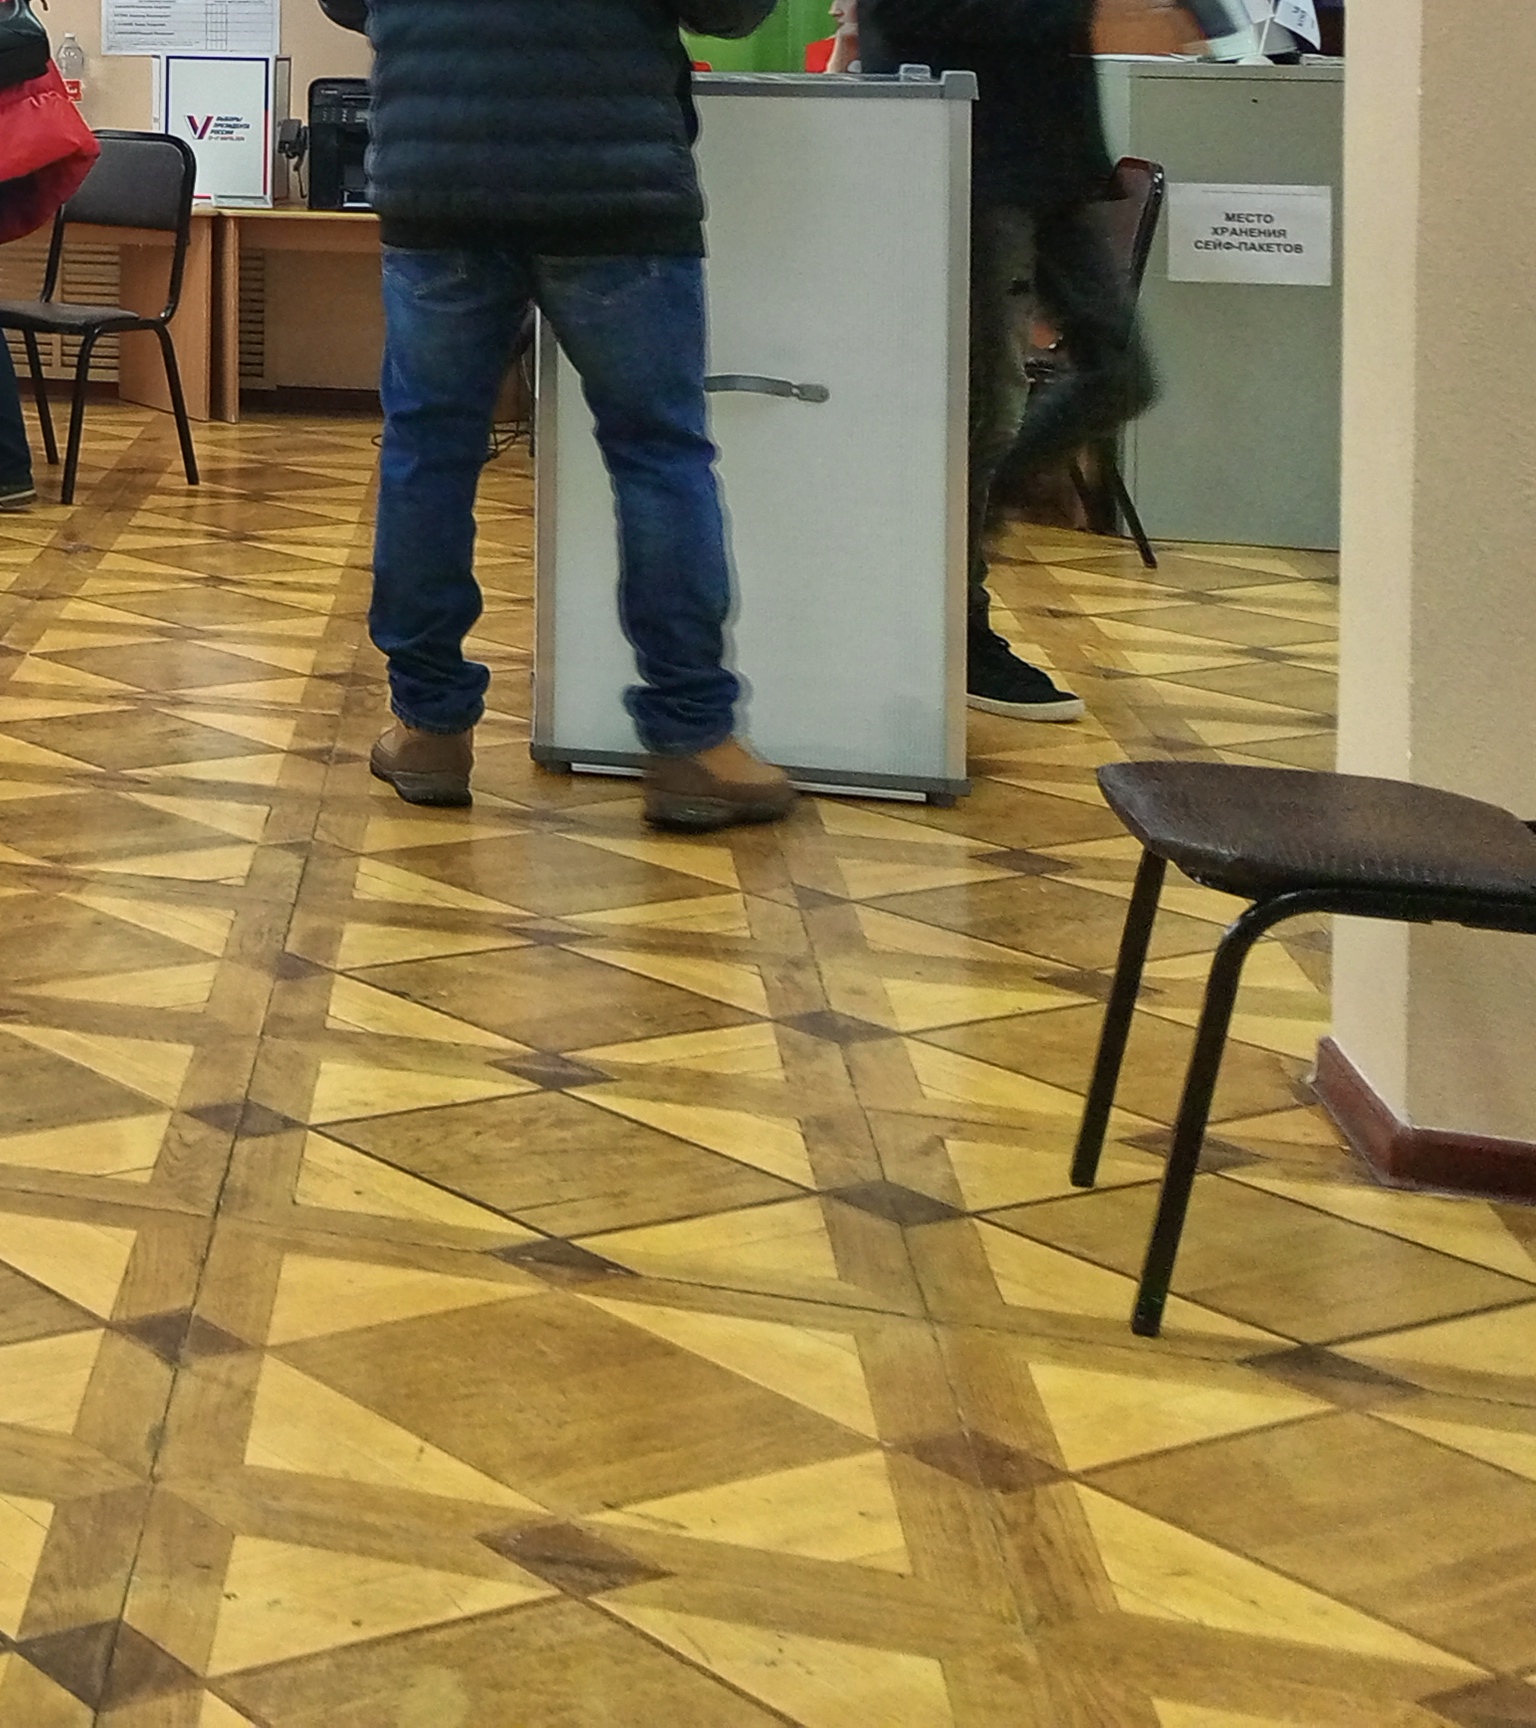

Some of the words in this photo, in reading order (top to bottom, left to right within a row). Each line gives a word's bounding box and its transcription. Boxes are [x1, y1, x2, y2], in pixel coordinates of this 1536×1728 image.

[1223, 212, 1275, 225] МЕСТО
[1210, 225, 1288, 239] ХРАНЕНИЯ
[1193, 238, 1304, 255] СЕЙФ-ПАКЕТОВ
